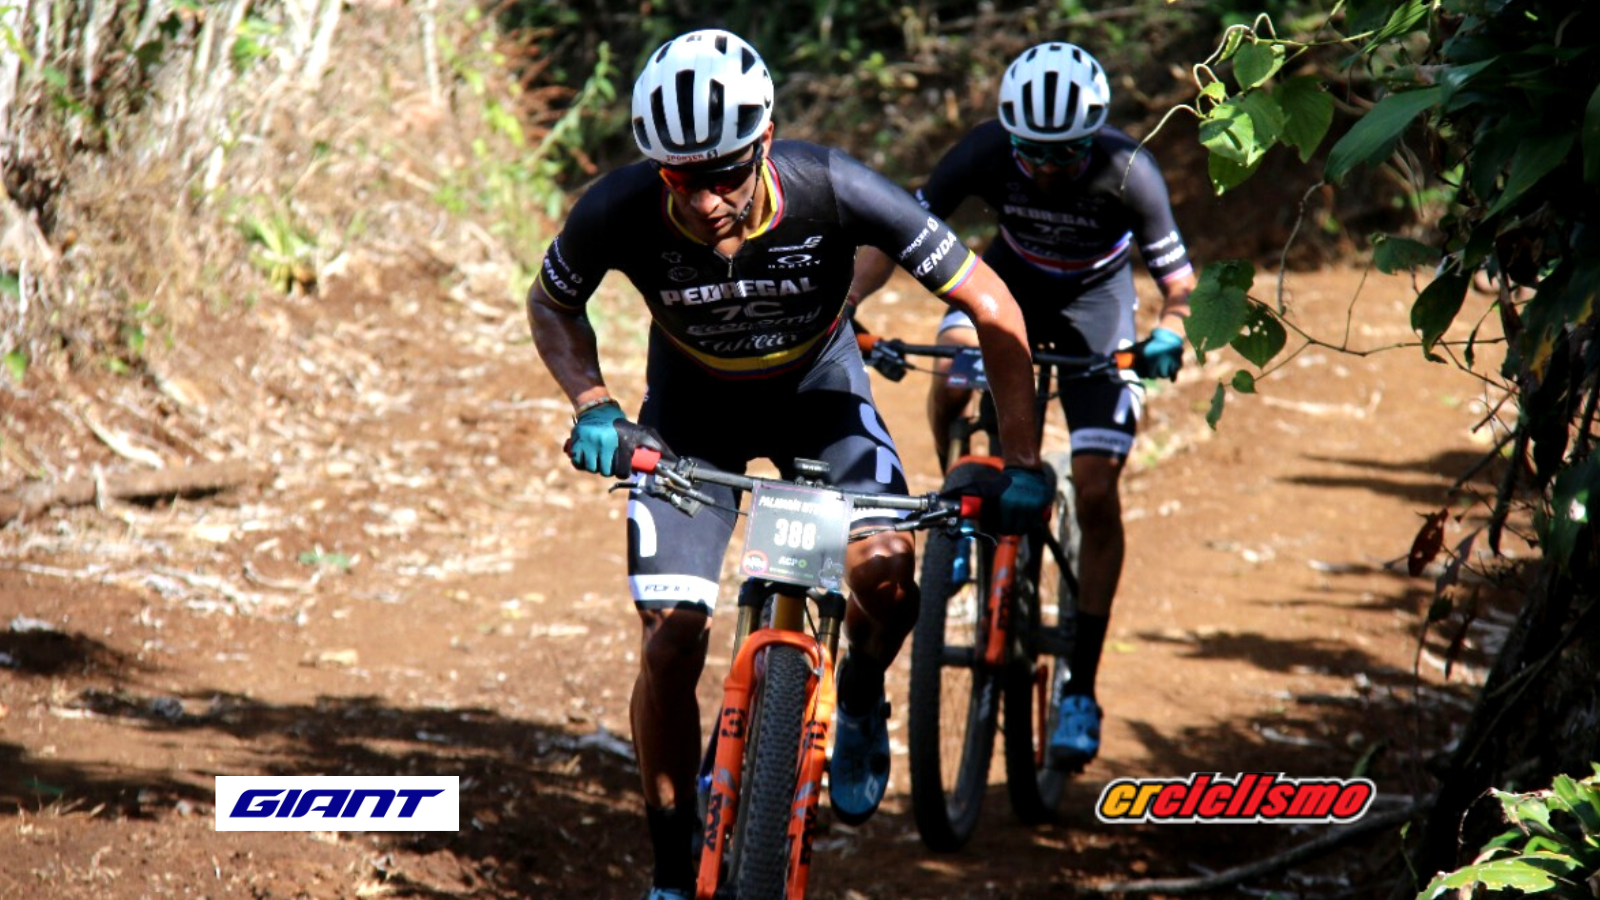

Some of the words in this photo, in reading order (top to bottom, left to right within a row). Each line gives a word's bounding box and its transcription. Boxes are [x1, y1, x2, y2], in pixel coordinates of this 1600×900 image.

[913, 230, 957, 278] KENDA
[659, 276, 817, 306] PEDREGAL
[711, 301, 785, 321] 7C
